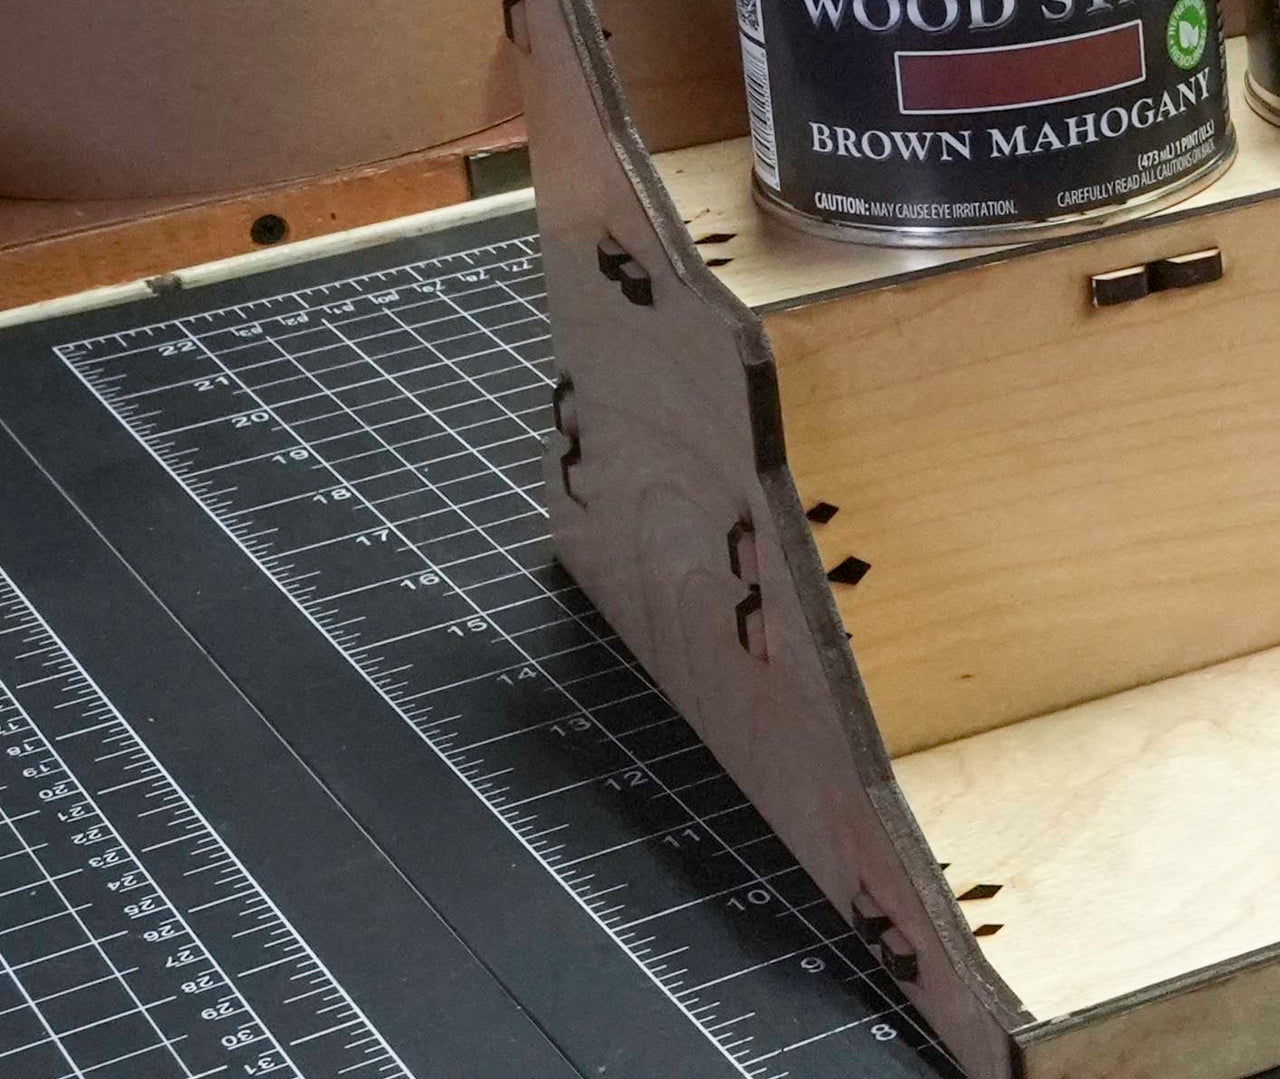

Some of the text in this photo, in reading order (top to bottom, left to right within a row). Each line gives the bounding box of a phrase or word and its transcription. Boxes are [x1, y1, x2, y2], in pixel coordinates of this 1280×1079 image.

[808, 66, 1211, 162] BROWN MAHOGANY
[1137, 150, 1160, 170] (473
[1057, 152, 1193, 207] CAREFULLY READ ALL CAUTIONS
[814, 191, 1018, 219] CAUTION: MAY CAUSE EYE IRRITATION.
[157, 340, 195, 358] 22
[231, 410, 271, 429] 20
[312, 488, 352, 505] 18
[400, 571, 440, 591] 16
[496, 664, 537, 687] 14
[604, 771, 650, 794] 12
[727, 888, 771, 911] 10
[870, 1023, 897, 1040] 8
